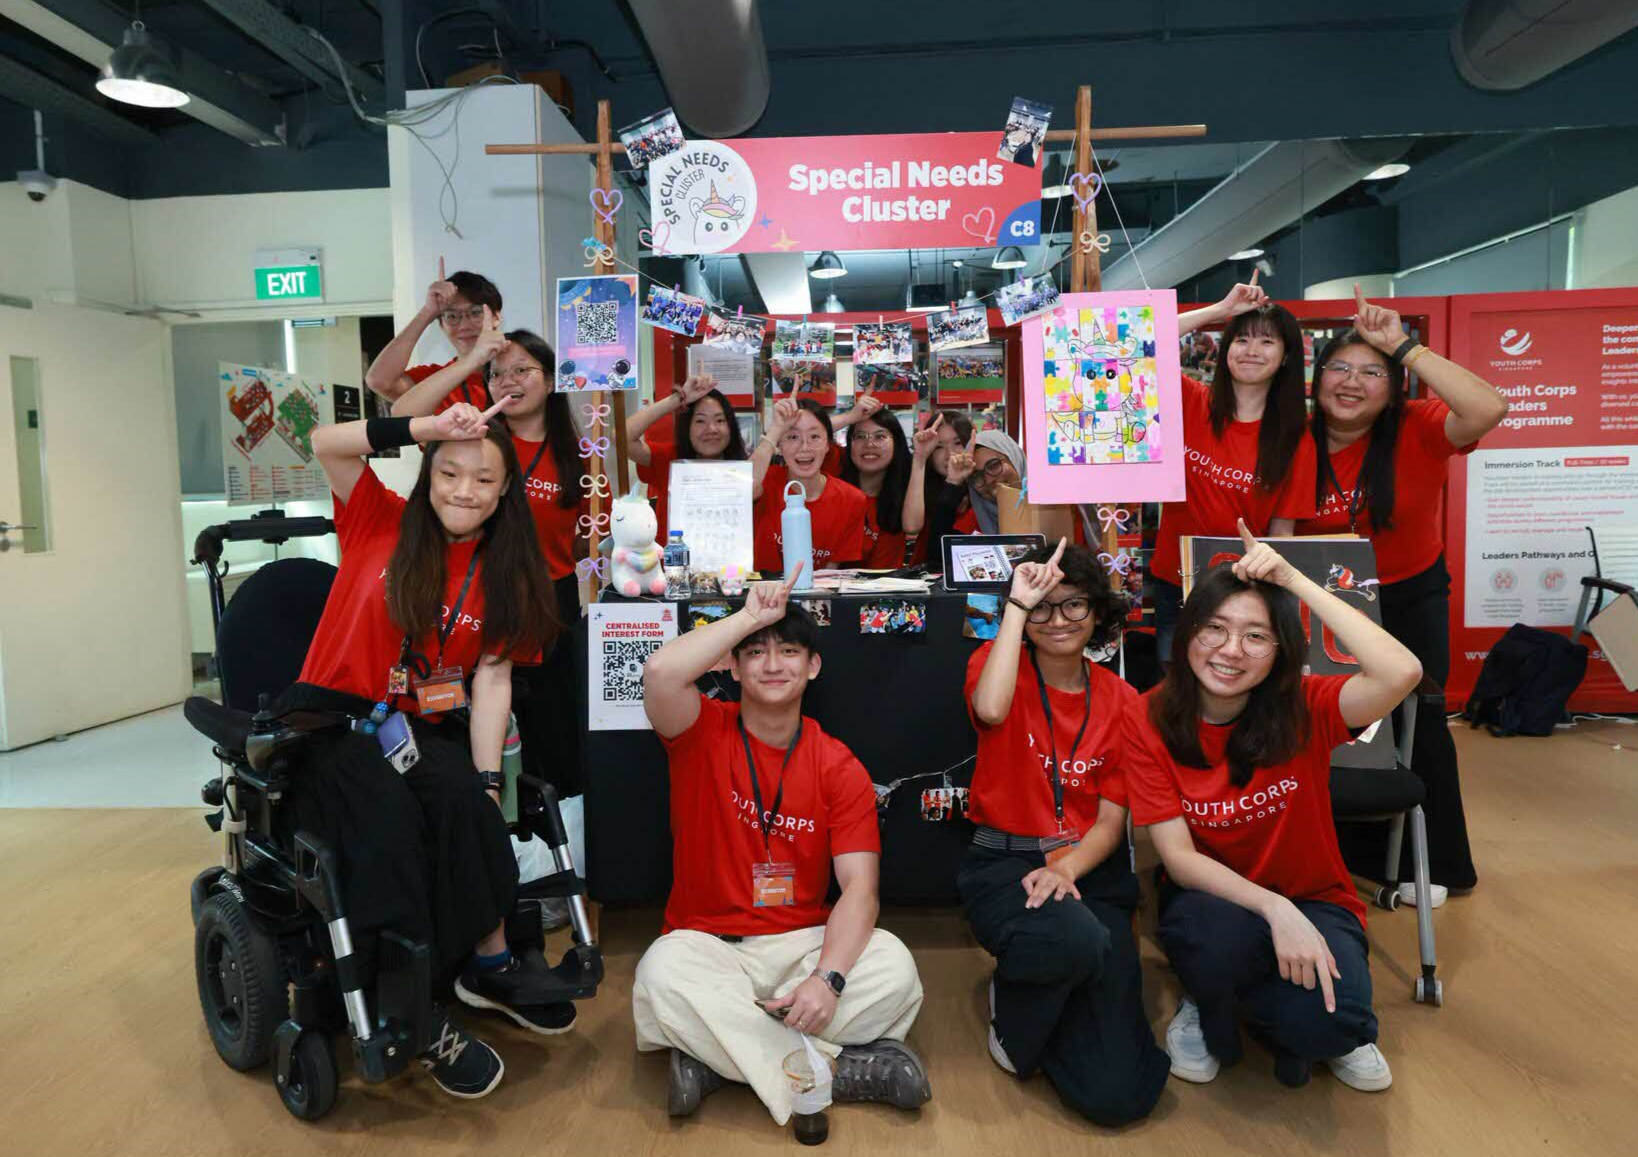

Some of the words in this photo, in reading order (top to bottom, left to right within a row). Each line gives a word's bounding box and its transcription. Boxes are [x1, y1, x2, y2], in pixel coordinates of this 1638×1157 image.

[675, 168, 705, 200] CLUSTER
[788, 160, 899, 196] Special
[908, 156, 1004, 188] Needs
[660, 166, 682, 225] SPECIAL
[681, 152, 729, 173] NEEDS
[842, 195, 952, 223] Cluster
[1010, 220, 1035, 238] C8
[267, 271, 307, 296] EXIT
[1517, 358, 1542, 366] CORPS
[344, 390, 351, 404] 2
[1496, 384, 1531, 397] outh
[1534, 384, 1577, 399] Corps
[1508, 399, 1547, 412] aders
[1484, 459, 1534, 469] Immersion
[1536, 459, 1561, 468] Track
[1482, 552, 1519, 560] Leaders
[1521, 551, 1566, 560] Pathways
[1567, 550, 1586, 558] and
[601, 630, 640, 638] INTEREST
[641, 630, 664, 638] FORM
[605, 622, 660, 630] CENTRALISED
[1181, 798, 1236, 816] OUTH
[1190, 801, 1287, 829] SINGAPORE
